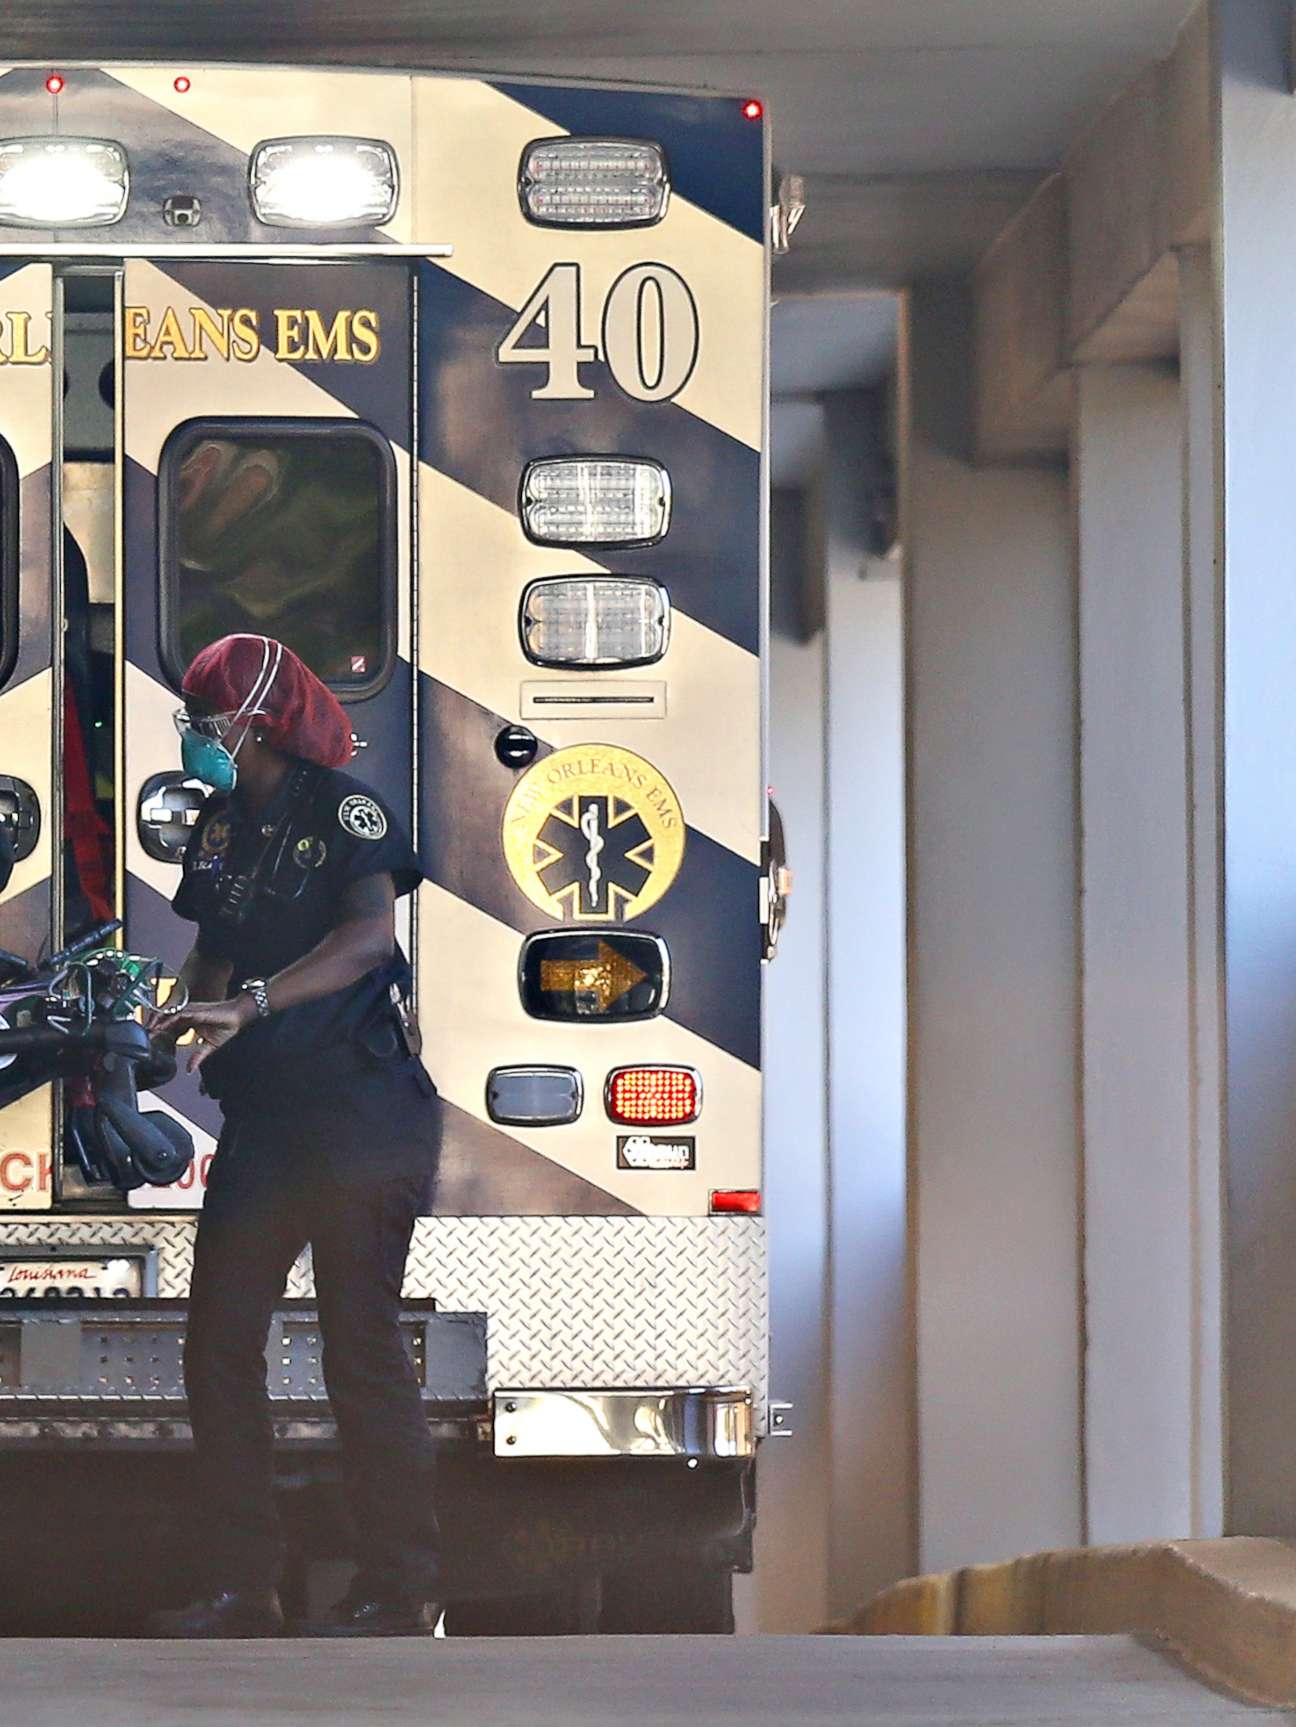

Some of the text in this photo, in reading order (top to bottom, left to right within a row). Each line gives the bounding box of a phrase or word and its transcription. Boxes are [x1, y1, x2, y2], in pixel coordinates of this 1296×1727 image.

[272, 307, 382, 365] EMS
[497, 261, 701, 403] 40
[547, 758, 647, 789] ORLEANS
[646, 787, 678, 829] EMS
[7, 1264, 97, 1284] Louisiana
